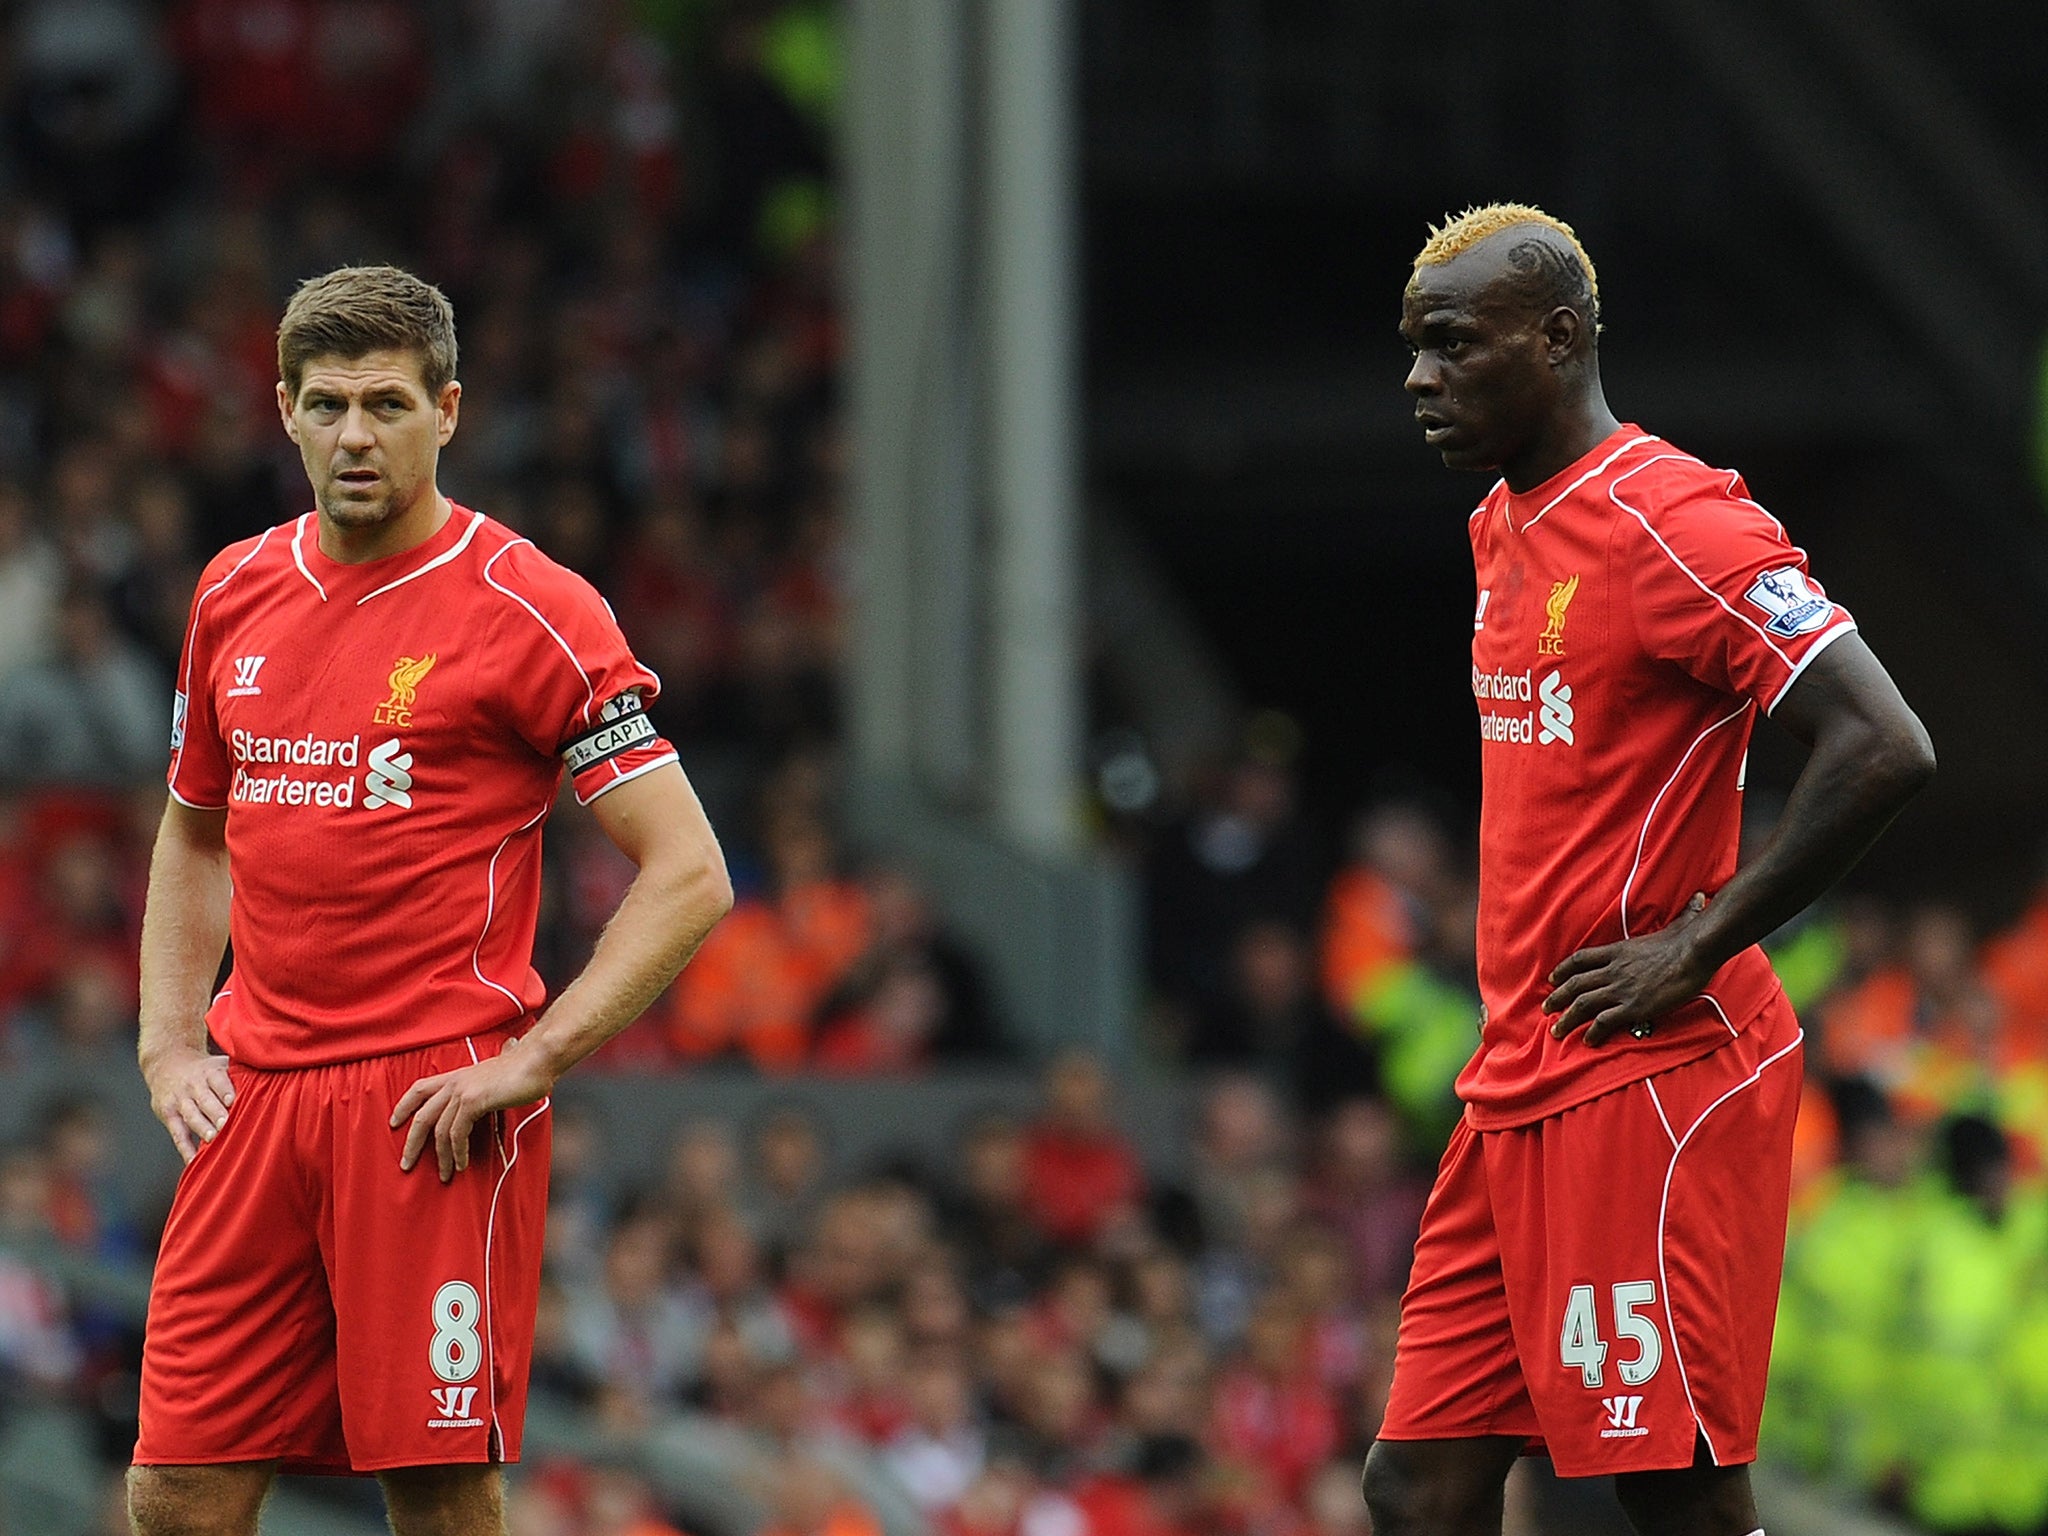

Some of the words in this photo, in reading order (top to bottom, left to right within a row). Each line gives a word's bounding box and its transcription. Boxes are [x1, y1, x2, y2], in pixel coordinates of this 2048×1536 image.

[1480, 710, 1534, 744] artered
[231, 728, 360, 767] Standard
[232, 768, 355, 808] Chartered
[428, 1280, 483, 1384] 8
[1560, 1280, 1662, 1388] 45
